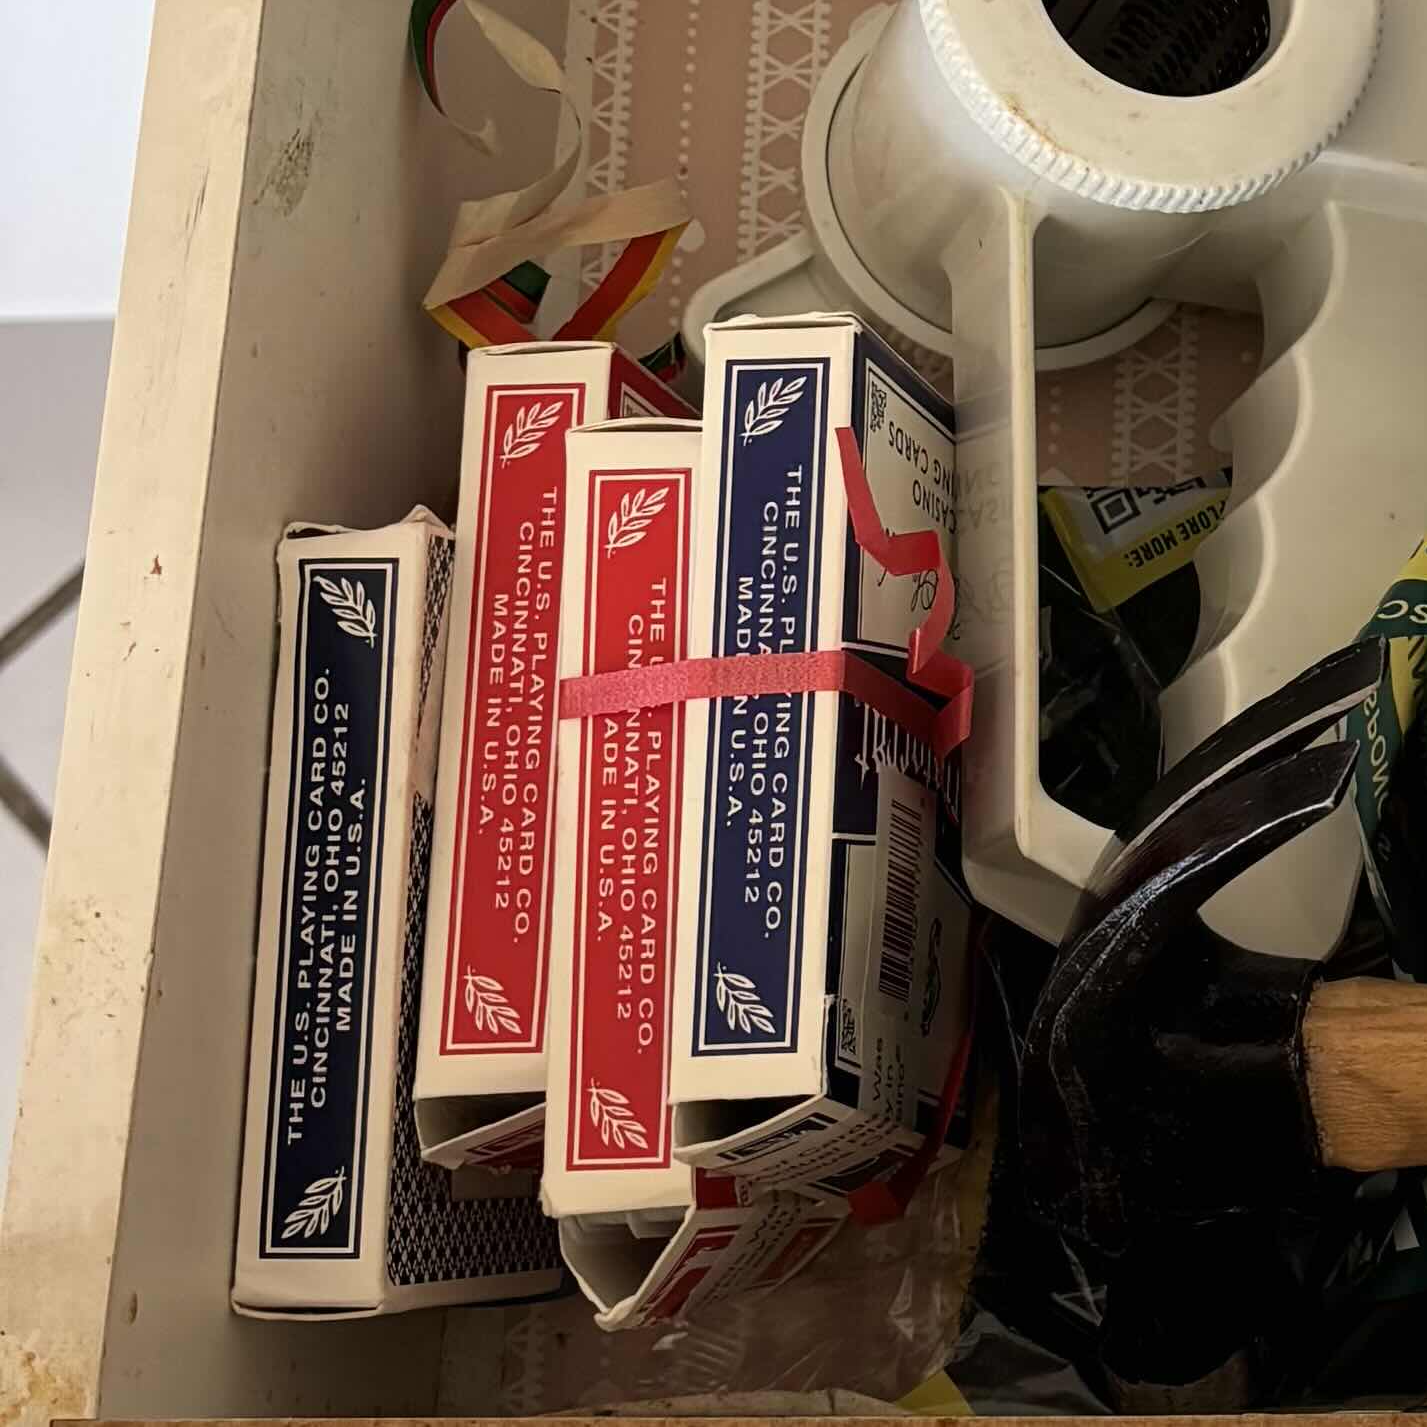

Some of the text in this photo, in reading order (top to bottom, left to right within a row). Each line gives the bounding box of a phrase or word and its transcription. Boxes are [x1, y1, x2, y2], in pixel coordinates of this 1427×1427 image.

[887, 421, 929, 476] CARDS
[648, 576, 667, 643] THE
[1122, 525, 1178, 569] MORE:
[478, 593, 510, 835] MADE IN U.S.A.
[494, 520, 535, 909] CINCINNATI, OHIO 45212
[513, 485, 558, 943] THE U.S. PLAYING CARD CO.
[726, 728, 747, 827] U.S.A.
[764, 464, 803, 939] THE U.S. CARD CO.
[597, 798, 617, 942] IN U.S.A.
[641, 730, 662, 875] PLAYING
[744, 711, 770, 904] OHIO 45212
[286, 668, 331, 1146] THE U.S. PLAYING CARD CO.
[309, 702, 350, 1109] CINCINNATI, OHIO 45212
[334, 778, 367, 1032] MADE IN U.S.A.
[616, 826, 638, 1019] OHIO 45212
[639, 887, 658, 985] CARD
[637, 996, 655, 1055] CO.
